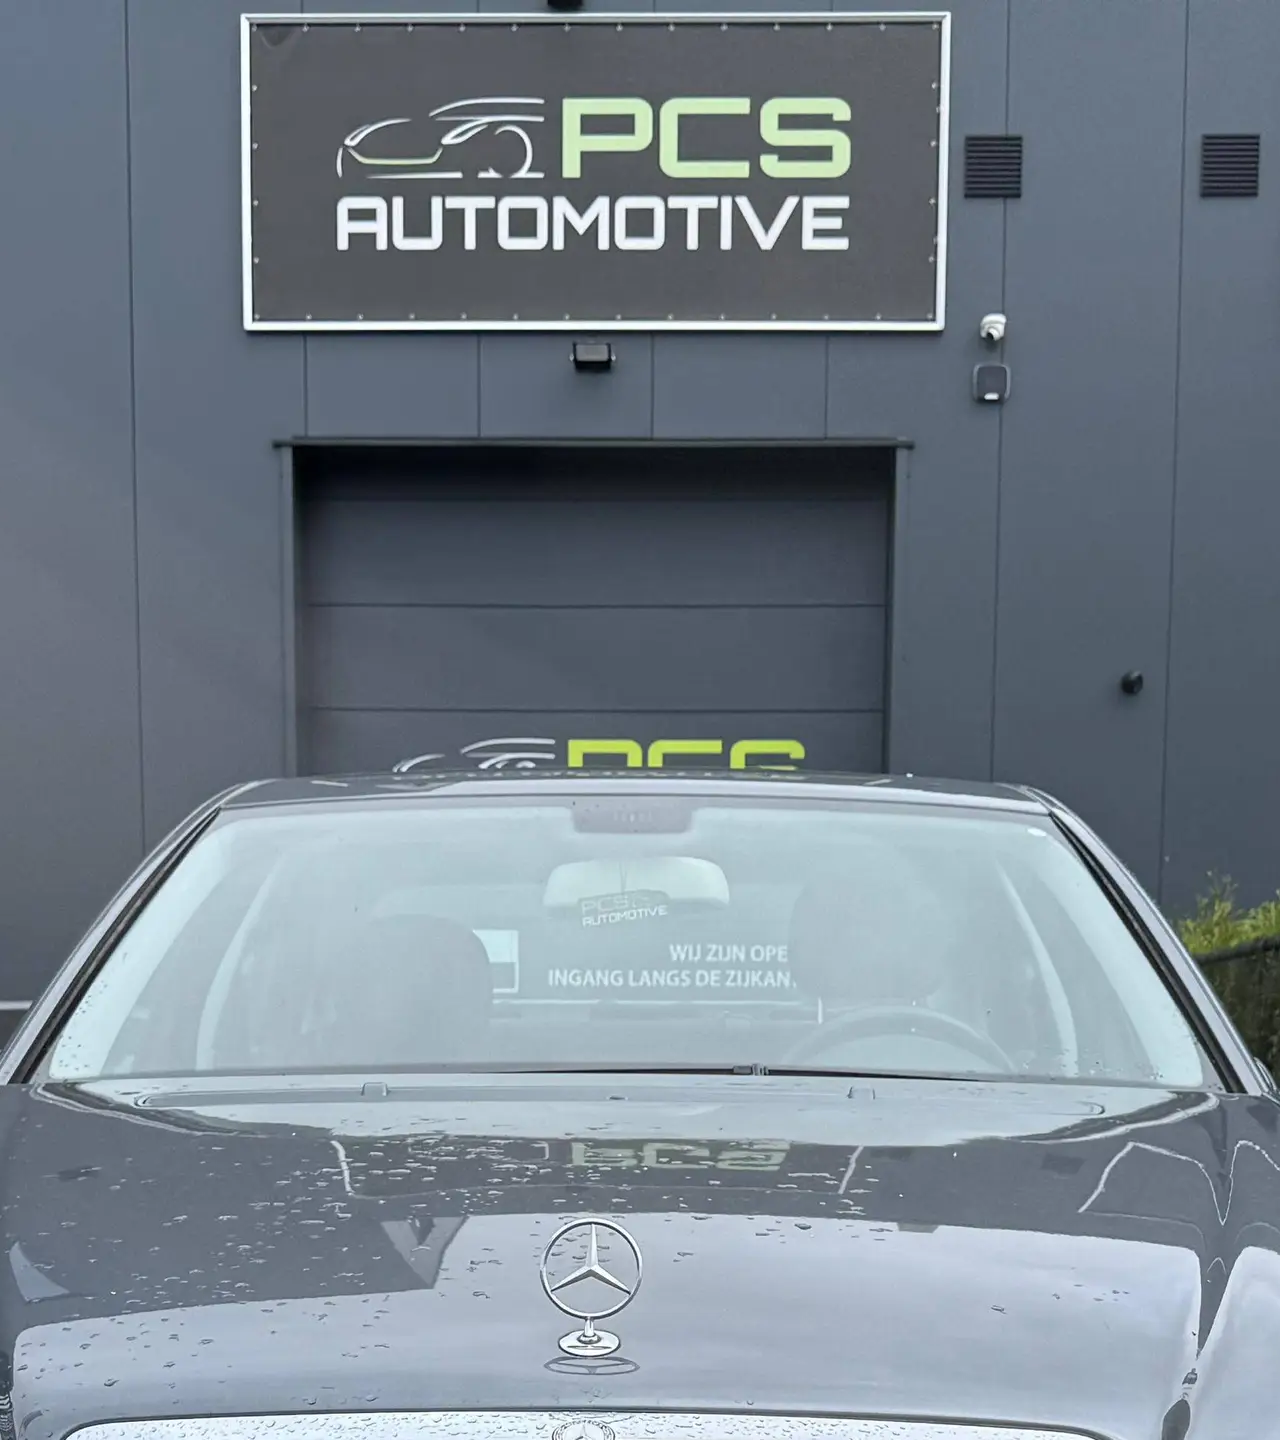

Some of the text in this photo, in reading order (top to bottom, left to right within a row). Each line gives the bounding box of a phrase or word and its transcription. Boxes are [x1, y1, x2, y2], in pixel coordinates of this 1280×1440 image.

[562, 97, 852, 179] PCS
[336, 195, 850, 251] AUTOMOTIVE
[581, 904, 669, 928] AUTOMOTIVE
[669, 943, 702, 963] WIJ
[706, 944, 746, 963] ZIJN
[548, 969, 797, 989] INGANG LANGS DE ZIJKAN
